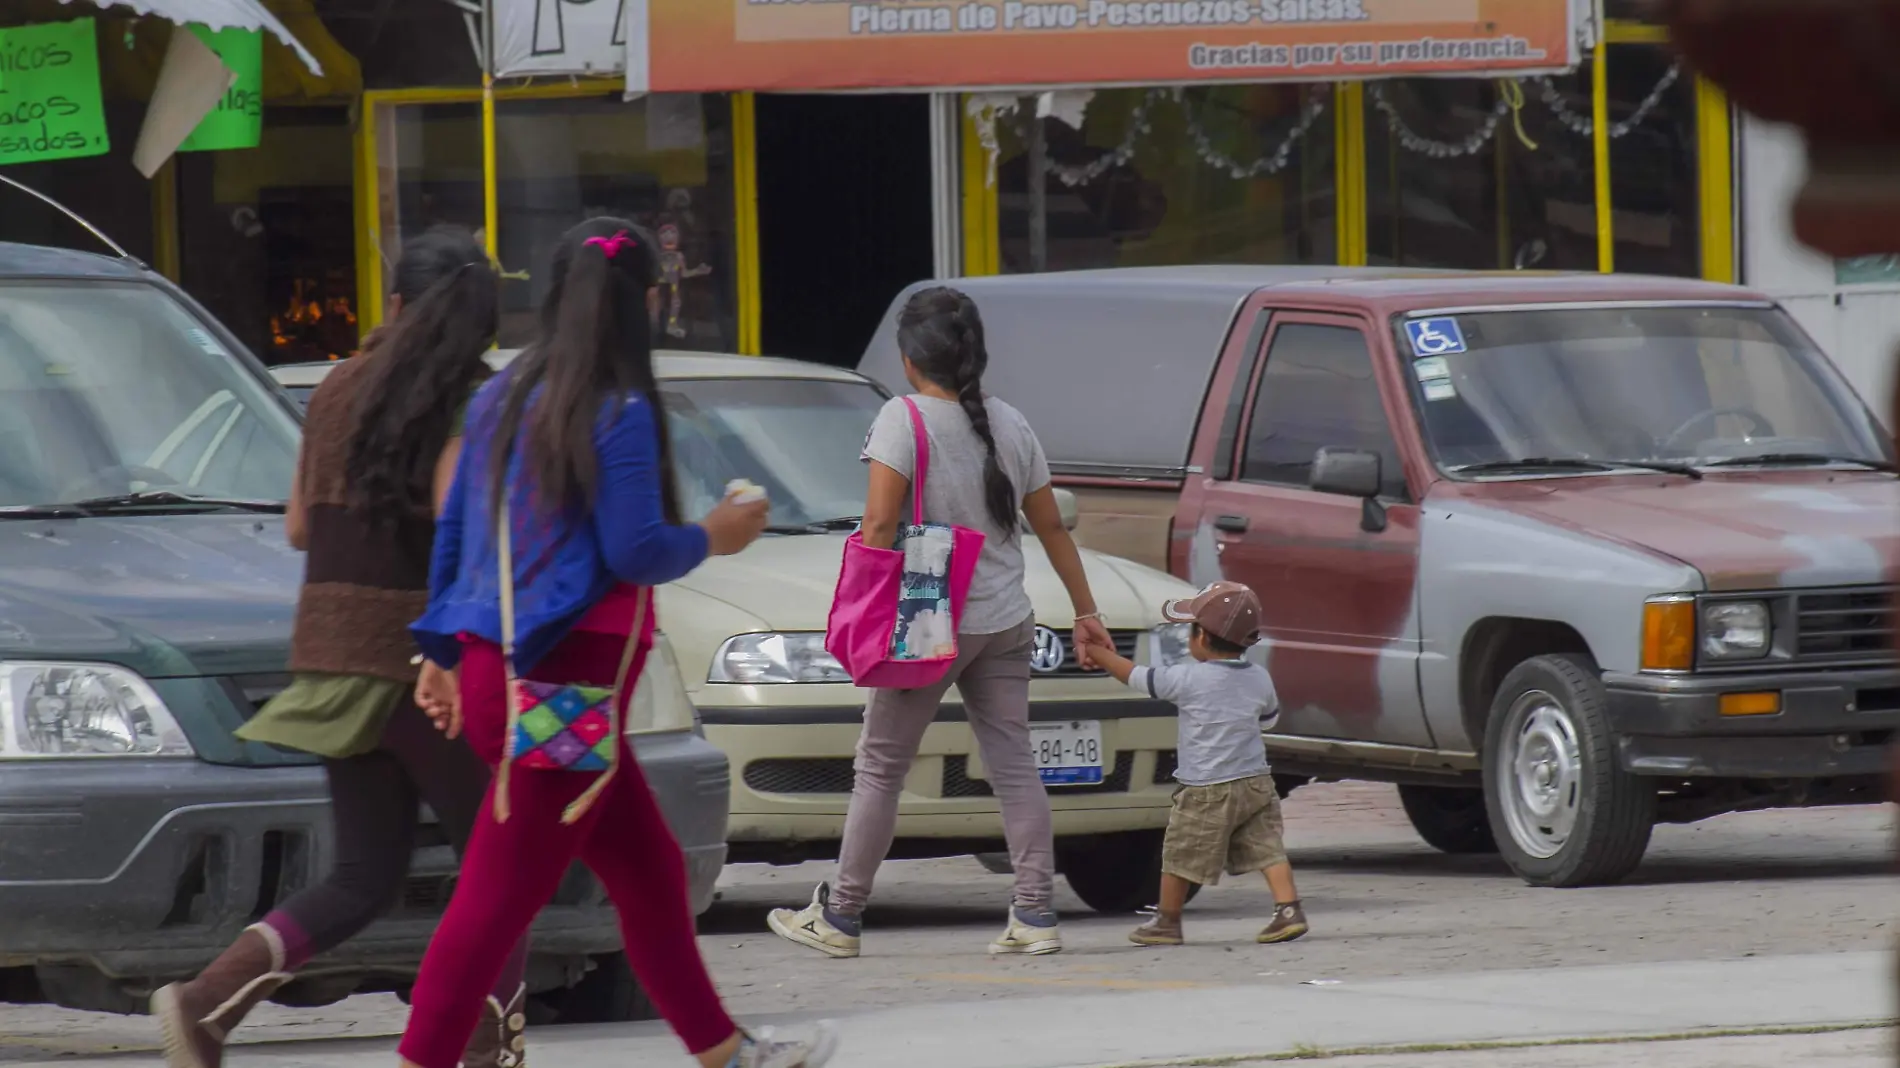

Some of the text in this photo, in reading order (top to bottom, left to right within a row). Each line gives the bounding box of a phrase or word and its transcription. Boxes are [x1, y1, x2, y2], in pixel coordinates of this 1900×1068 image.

[850, 4, 951, 33] Pierna
[957, 2, 996, 30] de
[1190, 42, 1289, 68] Gracias
[1293, 43, 1339, 68] por
[1341, 41, 1374, 64] su
